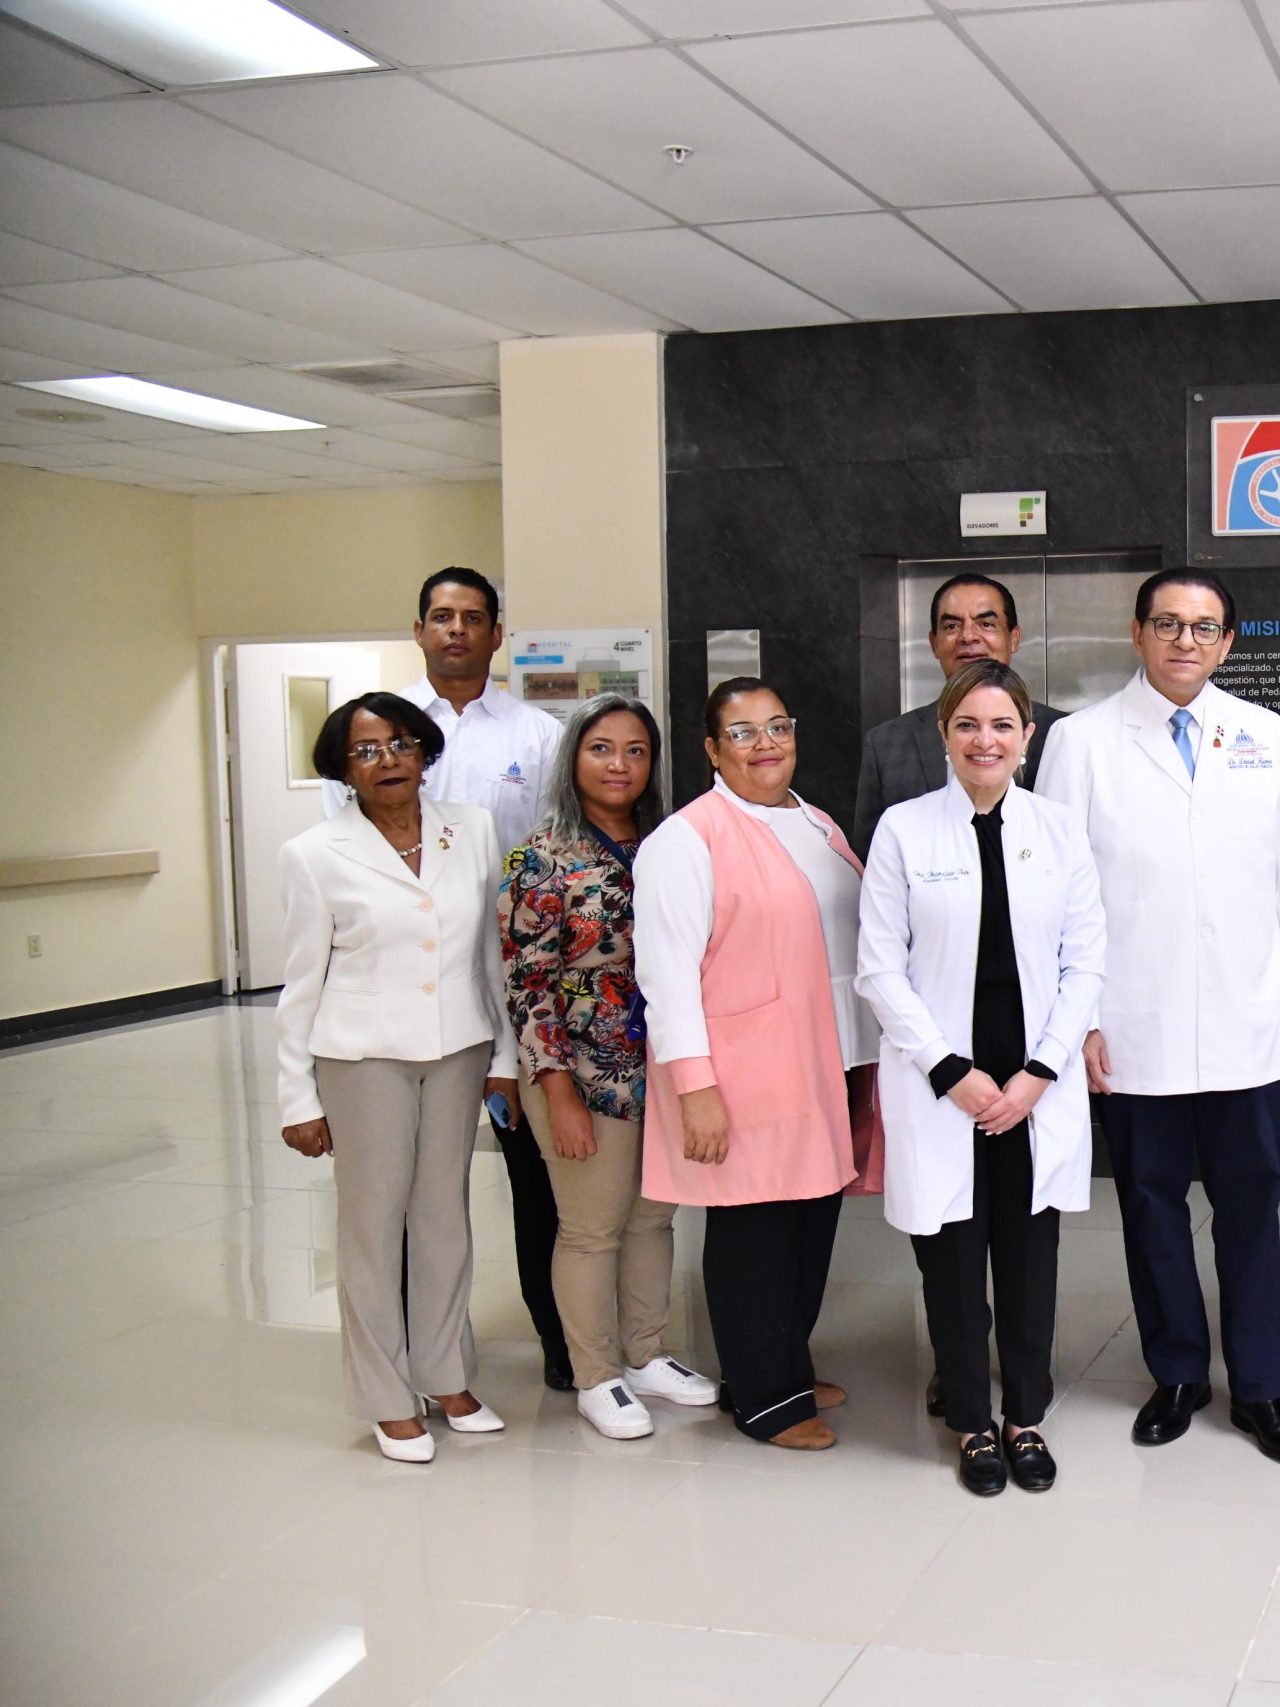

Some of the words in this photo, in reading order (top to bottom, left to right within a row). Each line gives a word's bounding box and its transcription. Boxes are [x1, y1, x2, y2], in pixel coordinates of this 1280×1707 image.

[613, 640, 620, 652] 4
[1254, 652, 1265, 660] un
[1260, 677, 1276, 686] que
[1248, 687, 1260, 696] de
